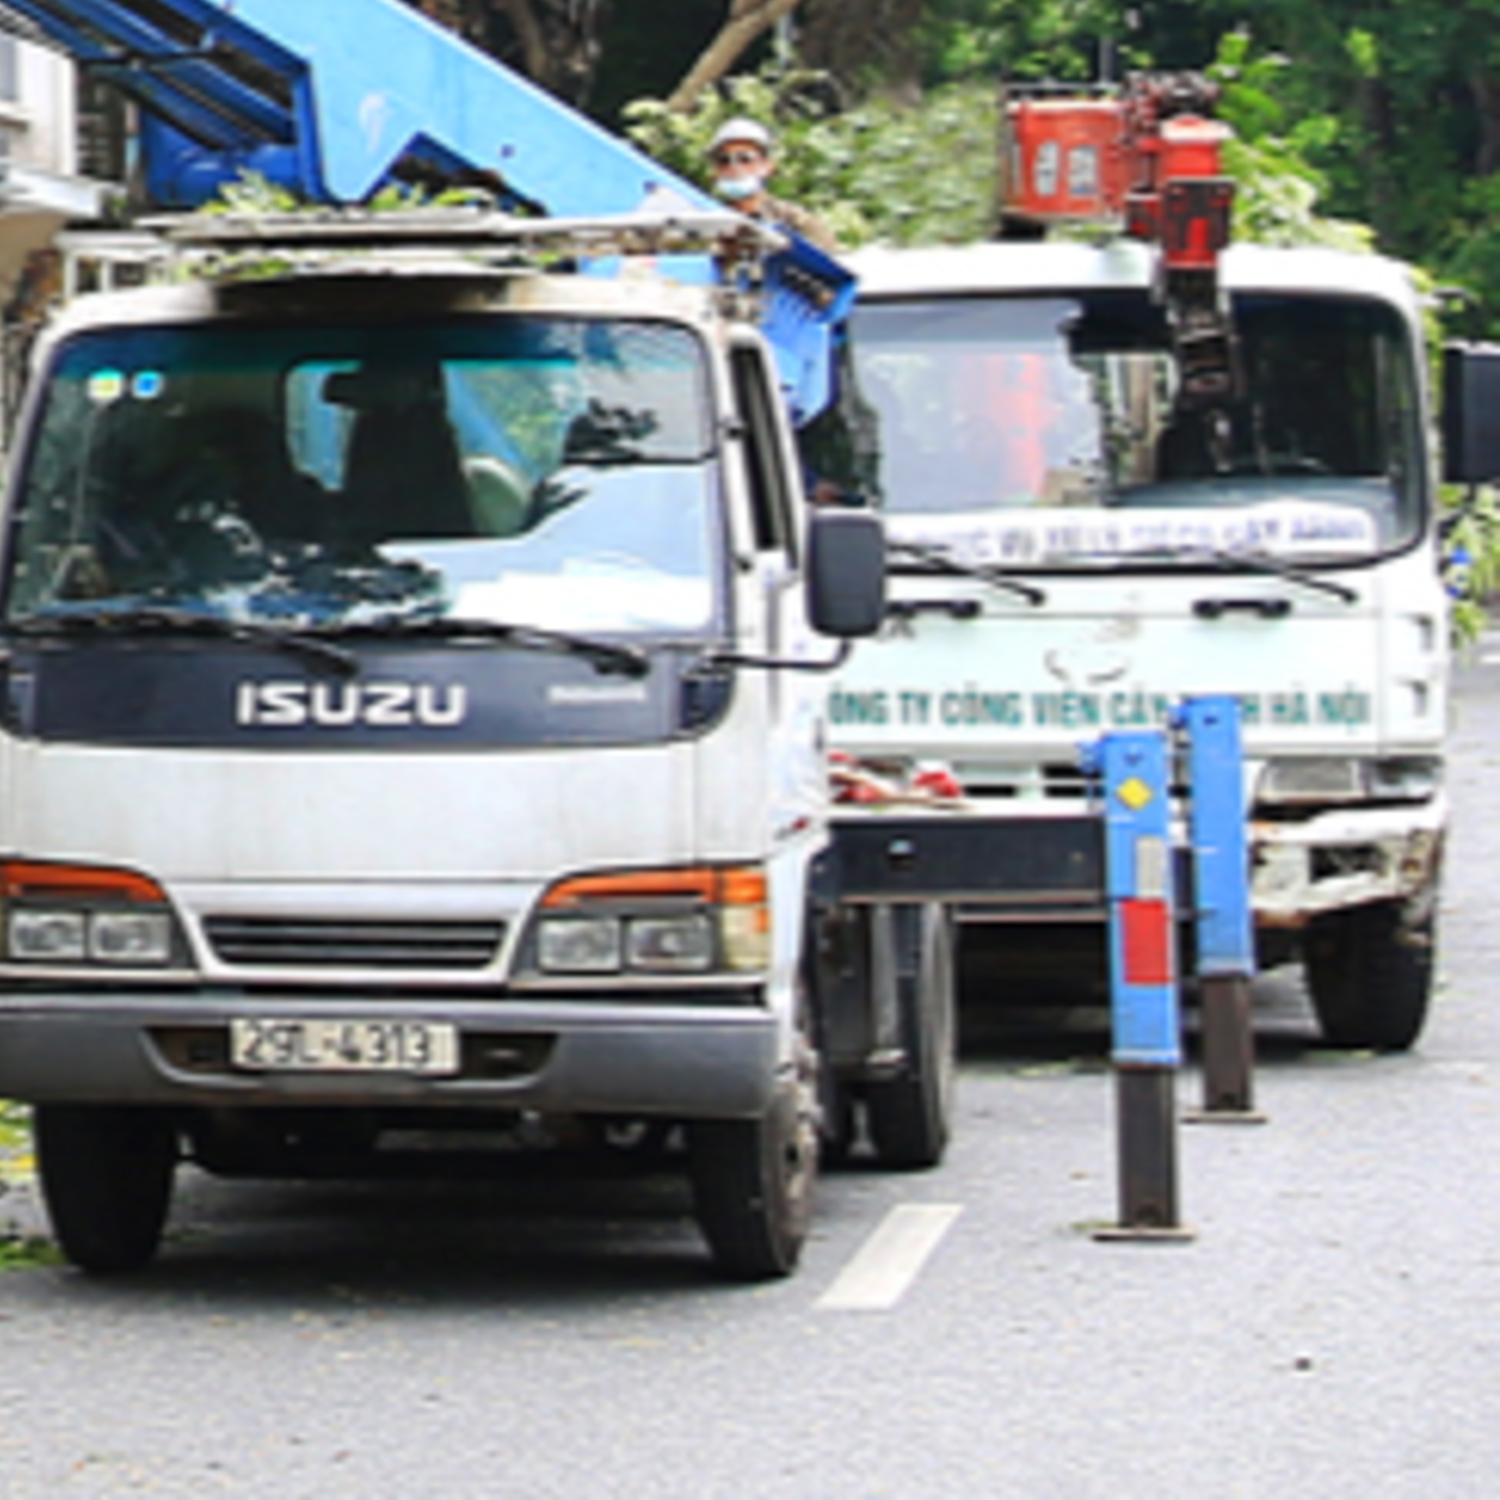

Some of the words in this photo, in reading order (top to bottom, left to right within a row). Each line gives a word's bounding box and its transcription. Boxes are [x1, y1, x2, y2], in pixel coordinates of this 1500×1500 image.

[236, 683, 467, 726] ISUZU
[827, 680, 890, 726] ÔNG
[899, 691, 932, 725] TY
[939, 679, 1024, 726] CÔNG
[243, 1021, 431, 1066] 29L-4313
